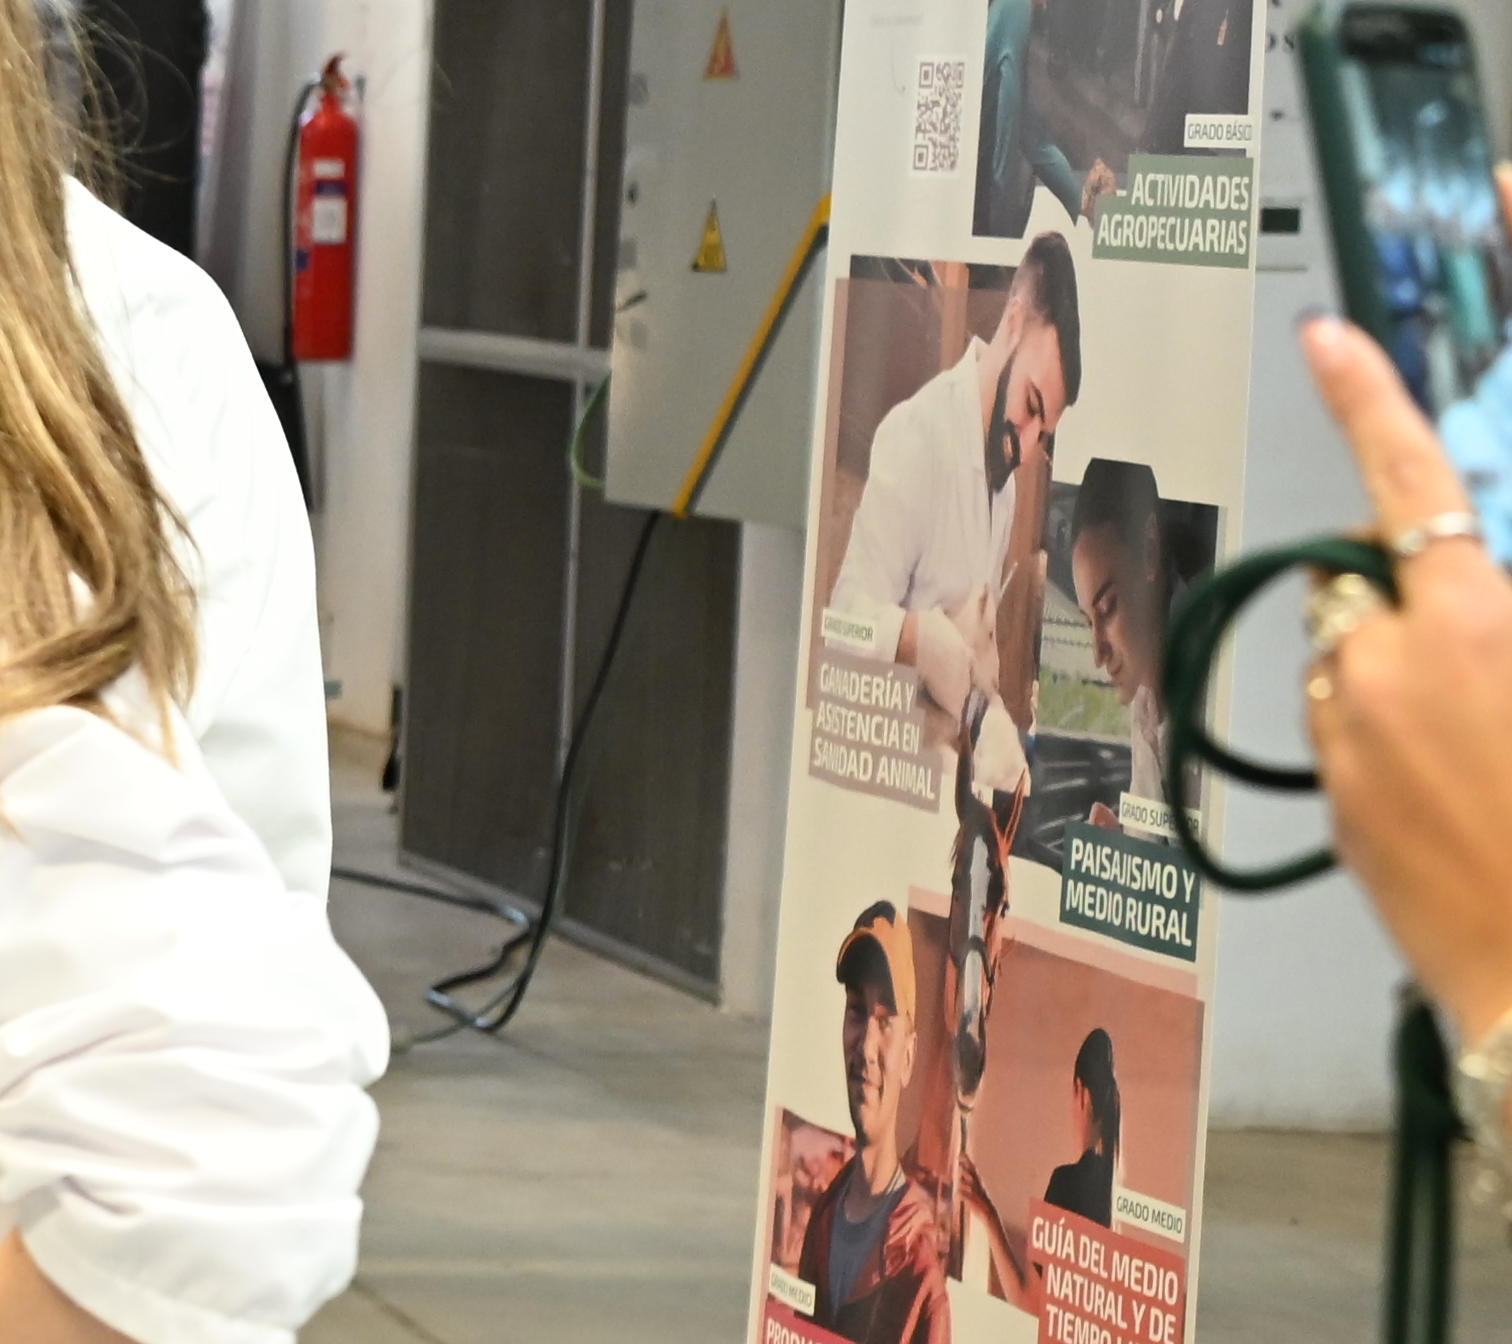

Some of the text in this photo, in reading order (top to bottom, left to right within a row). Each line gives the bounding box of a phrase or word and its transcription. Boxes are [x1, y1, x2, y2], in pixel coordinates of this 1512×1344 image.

[1187, 123, 1224, 140] GRADO
[1131, 173, 1250, 211] ACTIVIDADES
[1097, 213, 1248, 255] AGROPECUARIAS
[842, 619, 874, 643] SUPERIOR
[820, 663, 914, 714] GANADERÍA Y
[816, 701, 920, 755] ASISTENCIA EN
[814, 737, 936, 800] SANIDAD ANIMAL
[1121, 801, 1148, 824] GRADO
[1070, 837, 1196, 904] PAISAJISMO Y
[1066, 878, 1192, 947] MEDIO RURAL
[1116, 1195, 1183, 1235] GRADO MEDIO
[1032, 1215, 1178, 1306] GUÍA DEL MEDIO
[1046, 1263, 1128, 1330] NATURAL
[1132, 1299, 1146, 1335] Y
